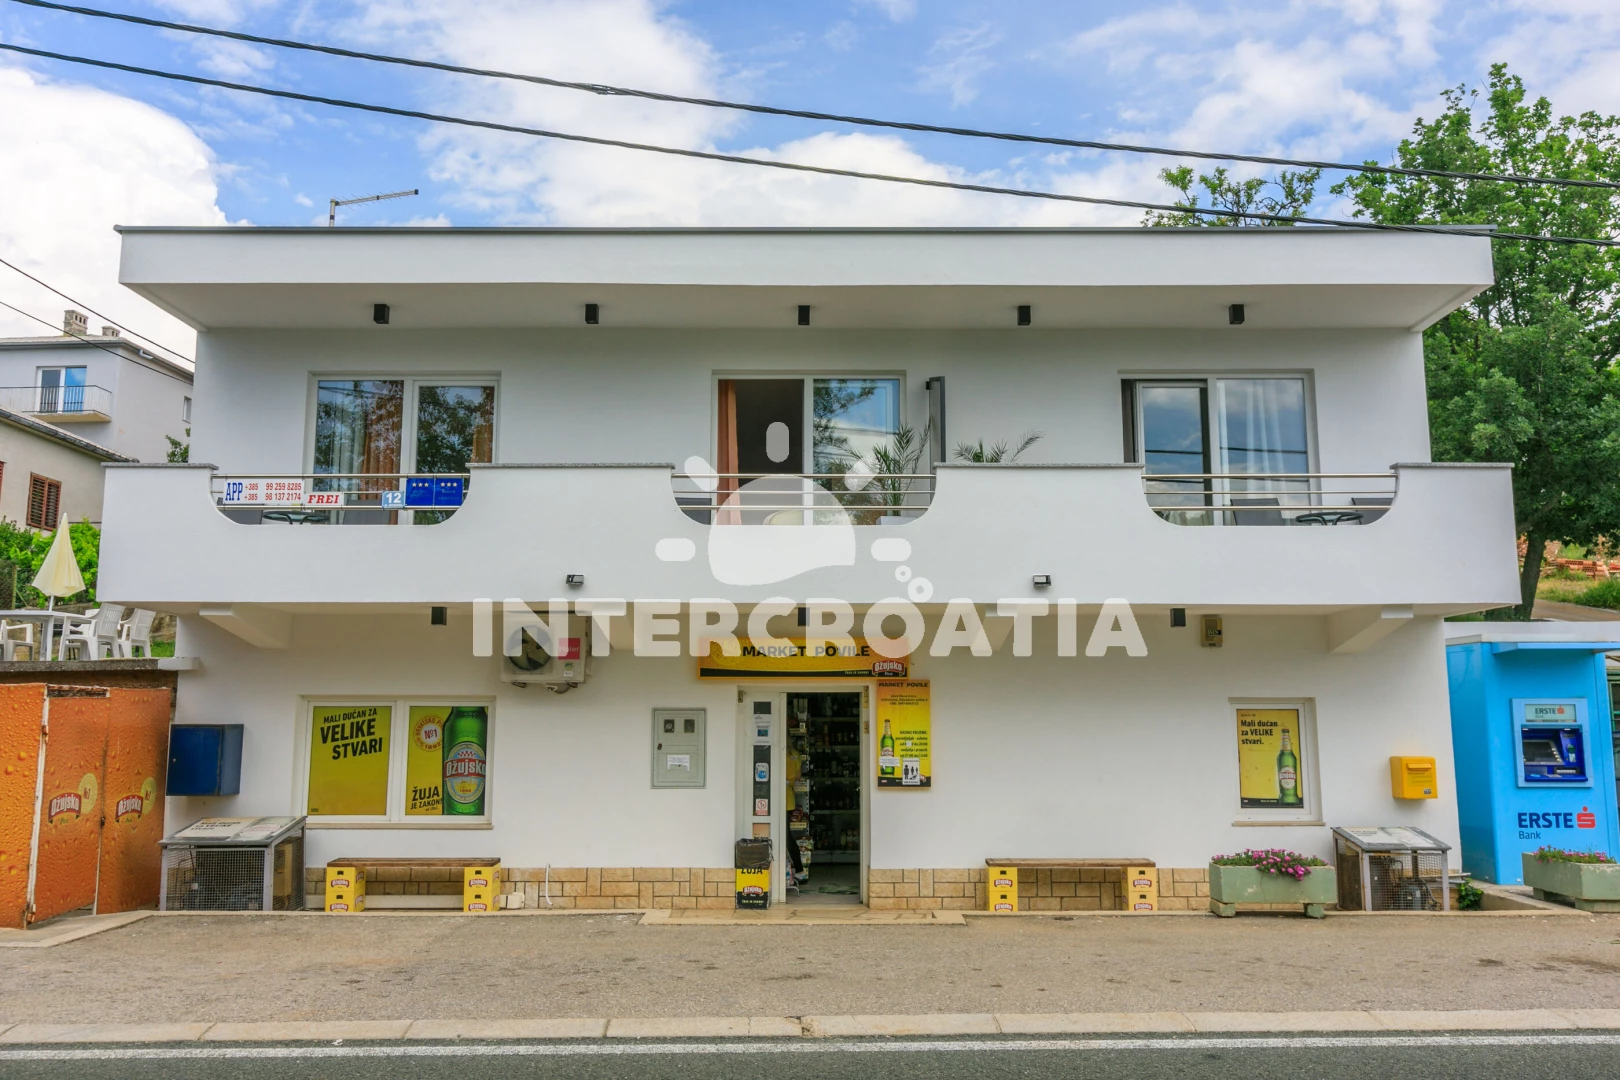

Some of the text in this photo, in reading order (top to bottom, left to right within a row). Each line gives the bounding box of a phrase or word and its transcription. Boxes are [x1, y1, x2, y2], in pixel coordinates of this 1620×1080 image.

[225, 482, 302, 501] APP +385 99 259 8285
[244, 492, 301, 501] +385 98 137 2174
[386, 492, 402, 504] 12
[307, 494, 340, 504] FREI
[742, 645, 870, 658] MARKET POVILE
[874, 660, 904, 672] Ožujsko
[323, 708, 378, 724] MALI DUĆAN ZA
[1534, 707, 1556, 715] ERSTE
[1240, 719, 1256, 727] Mali
[320, 718, 376, 744] VELIKE
[1249, 728, 1274, 736] VELIKE
[332, 737, 383, 760] STVARI
[446, 759, 487, 777] Ožujsko
[411, 785, 440, 802] ŽUJA
[51, 793, 79, 816] Ožujsko
[117, 796, 142, 815] Ožujsko
[410, 802, 417, 810] JE
[1517, 812, 1574, 829] ERSTE
[1518, 831, 1542, 840] Bank
